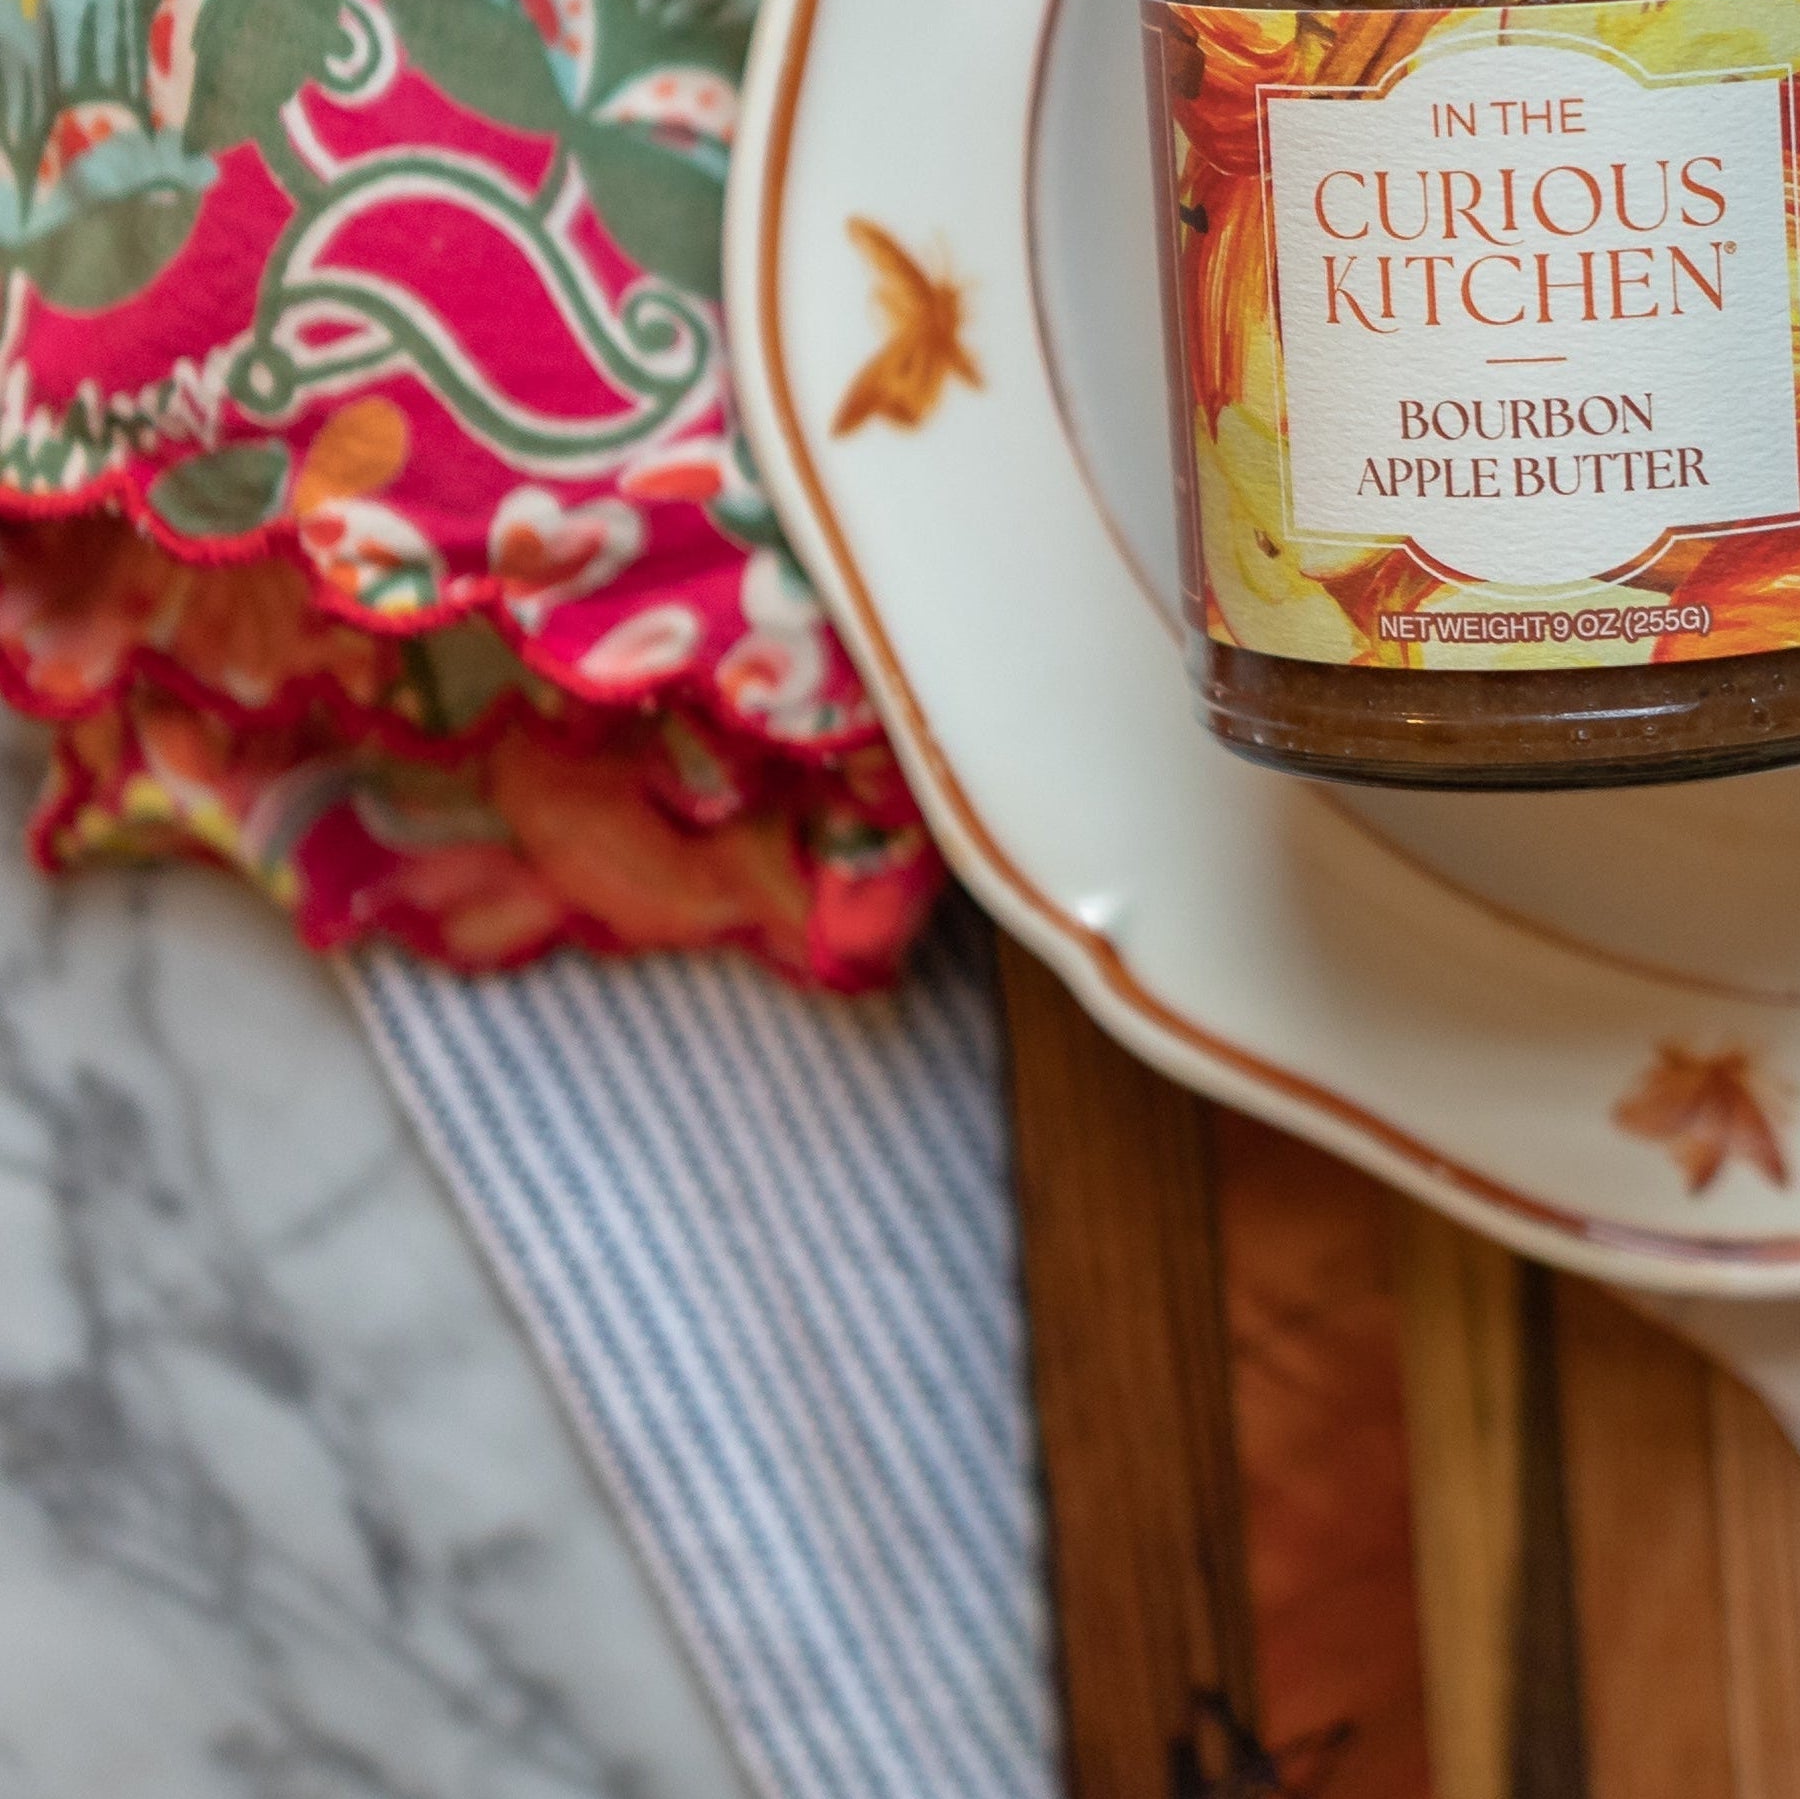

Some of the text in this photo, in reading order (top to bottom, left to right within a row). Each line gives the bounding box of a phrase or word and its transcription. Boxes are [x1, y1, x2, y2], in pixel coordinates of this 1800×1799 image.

[1432, 97, 1587, 137] IN THE
[1313, 156, 1728, 245] CURIOUS
[1399, 392, 1654, 441] BOURBON
[1357, 446, 1710, 499] APPLE BUTTER
[1380, 605, 1711, 640] NET WEIGHT 9 OZ (255G)
